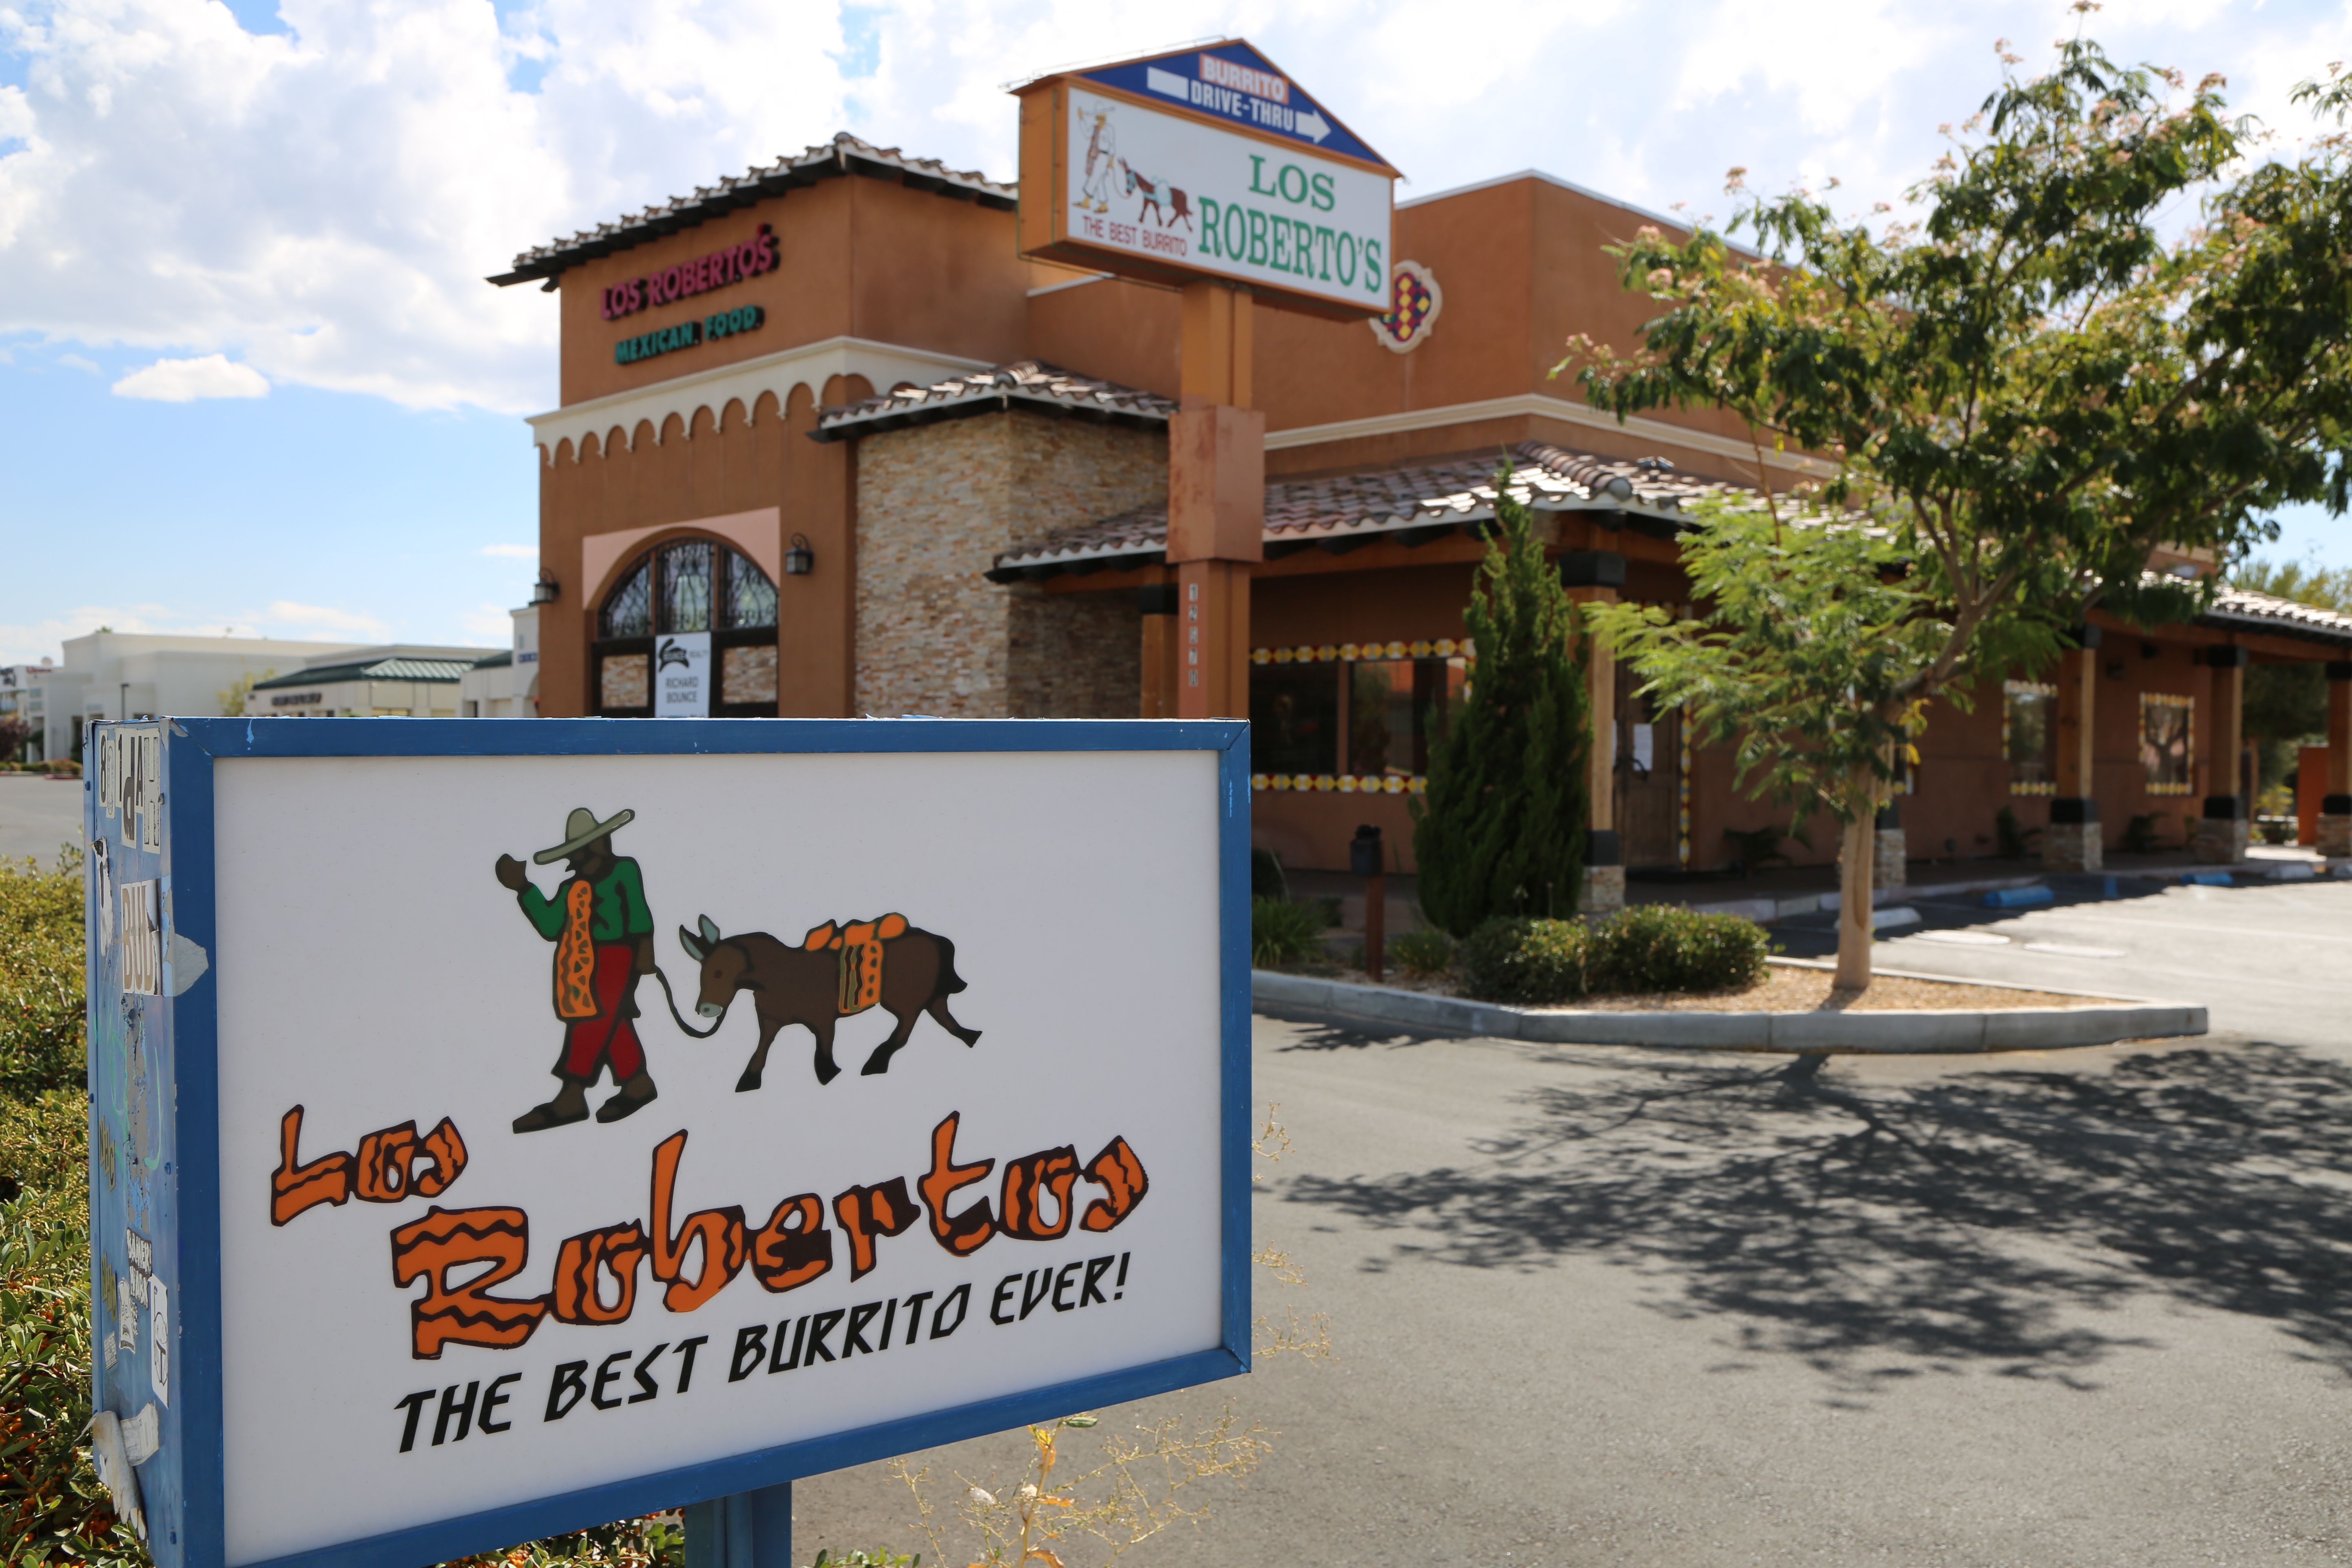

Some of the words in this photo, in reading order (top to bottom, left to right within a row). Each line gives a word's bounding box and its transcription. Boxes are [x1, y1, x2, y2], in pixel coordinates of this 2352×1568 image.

[1190, 80, 1295, 131] DRIVE-THRU
[1203, 57, 1285, 100] BURRITO
[1249, 154, 1335, 211] LOS
[1083, 216, 1104, 239] THE
[1109, 223, 1137, 245] BEST
[1144, 230, 1187, 257] BURRITO
[1198, 196, 1381, 293] ROBERTO'S
[601, 278, 642, 319] LOS
[615, 322, 695, 364] MEXICAN
[705, 305, 759, 340] FOOD
[666, 677, 698, 688] RICHARD
[667, 691, 697, 704] BOUNCE
[271, 1104, 468, 1227] Los
[390, 1110, 1149, 1360] Robertos
[393, 1372, 522, 1453] THE
[543, 1335, 708, 1422] BEST
[728, 1283, 971, 1383] BURRITO
[989, 1252, 1131, 1326] EVER!
